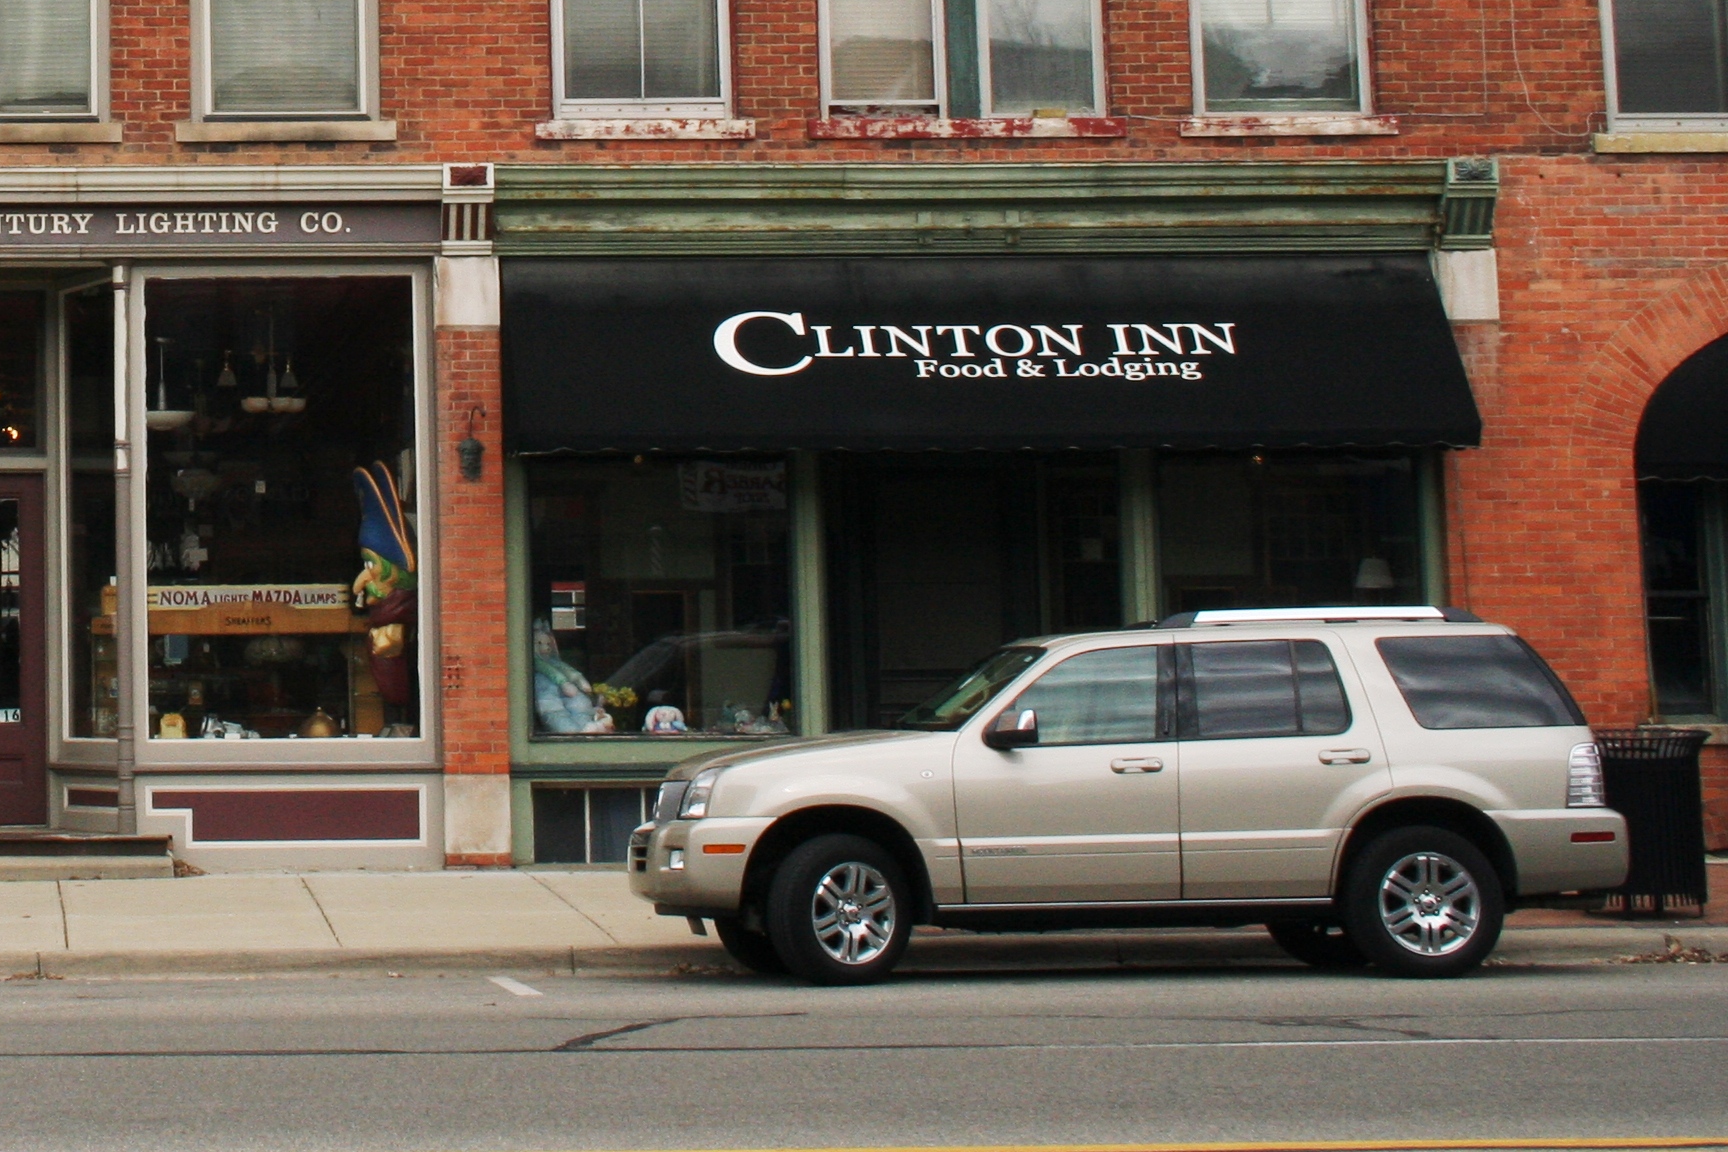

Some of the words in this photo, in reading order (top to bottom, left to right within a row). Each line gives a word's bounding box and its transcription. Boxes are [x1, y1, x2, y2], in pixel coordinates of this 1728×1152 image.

[115, 212, 279, 235] LIGHTING
[300, 211, 352, 234] CO.
[713, 311, 1083, 377] CLINTON
[1106, 322, 1236, 355] INN
[914, 358, 1007, 379] Food
[1016, 358, 1046, 379] &
[1056, 357, 1203, 382] Lodging
[160, 591, 213, 606] NOMA
[214, 593, 250, 603] LIGHTS
[252, 590, 303, 605] MAZDA
